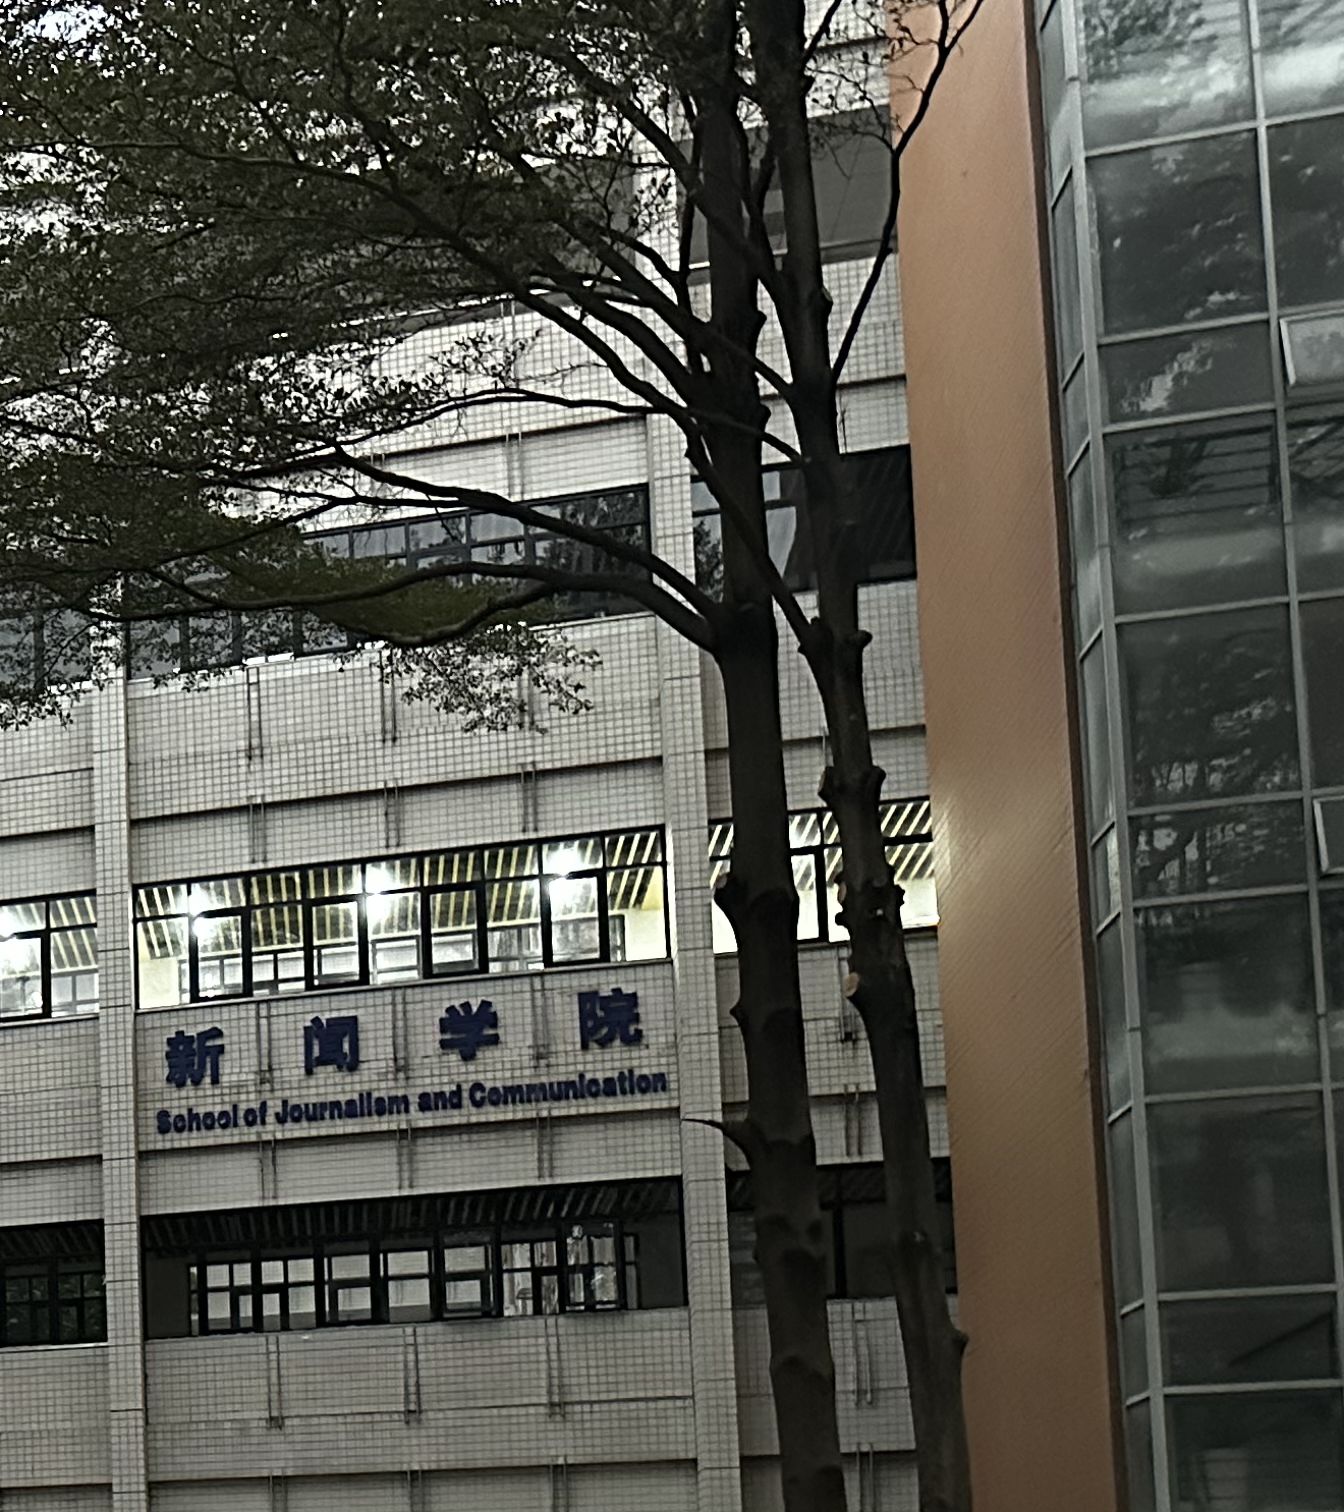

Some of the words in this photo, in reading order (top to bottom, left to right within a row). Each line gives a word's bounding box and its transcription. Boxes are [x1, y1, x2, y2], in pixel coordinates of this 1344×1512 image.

[165, 986, 644, 1088] 新闻学院
[156, 1103, 239, 1134] School
[243, 1100, 268, 1127] of
[274, 1091, 410, 1125] Journalism
[417, 1083, 463, 1113] and
[469, 1068, 667, 1108] Communication
